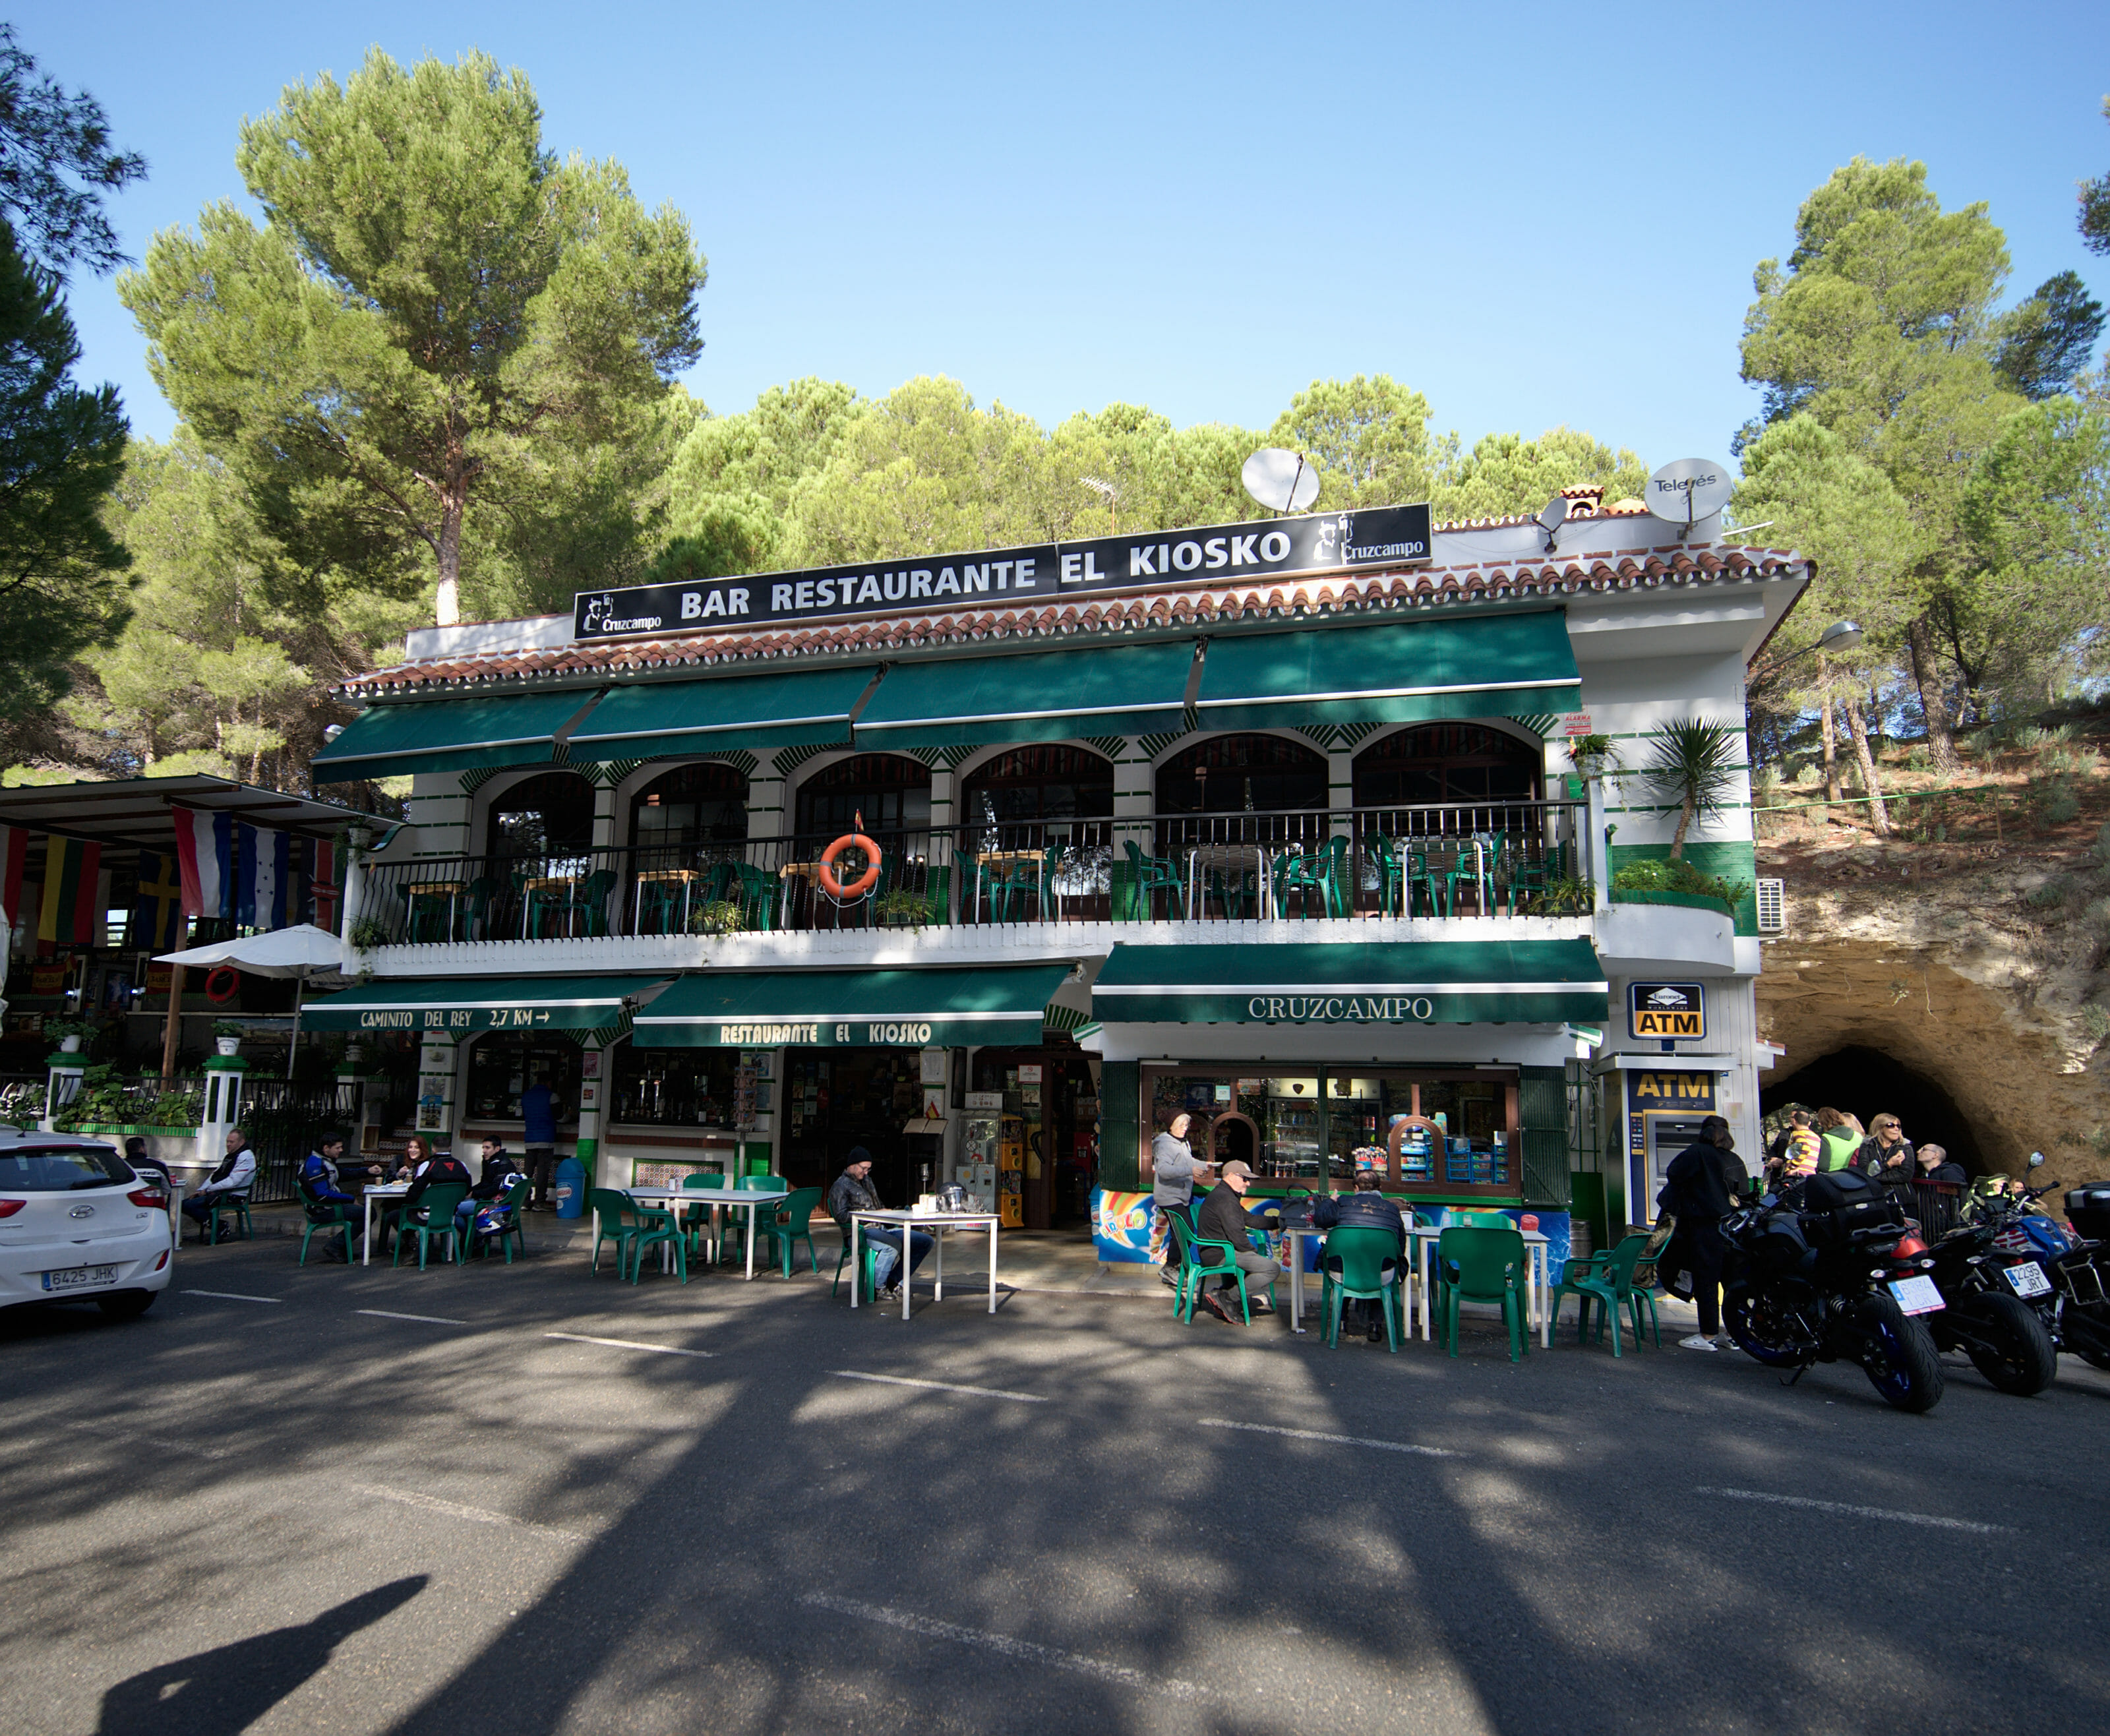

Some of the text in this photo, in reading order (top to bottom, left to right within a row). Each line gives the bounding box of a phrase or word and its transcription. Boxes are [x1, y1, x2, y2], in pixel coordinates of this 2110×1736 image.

[1344, 541, 1424, 559] Cruzcampo
[681, 531, 1291, 619] BAR RESTAURANTE EL KIOSKO
[602, 616, 662, 632] Cruzcampo
[1248, 997, 1433, 1019] CRUZCAMPO
[361, 1009, 532, 1027] CAMINITO DEL REY 2,7 KM
[1639, 1013, 1699, 1033] ATM
[721, 1023, 932, 1043] RESTAURANTE EL KIOSKO
[1637, 1074, 1709, 1098] ATM
[53, 1267, 114, 1285] 6425 JHK
[2014, 1264, 2040, 1280] 2295
[2027, 1276, 2043, 1290] JRT
